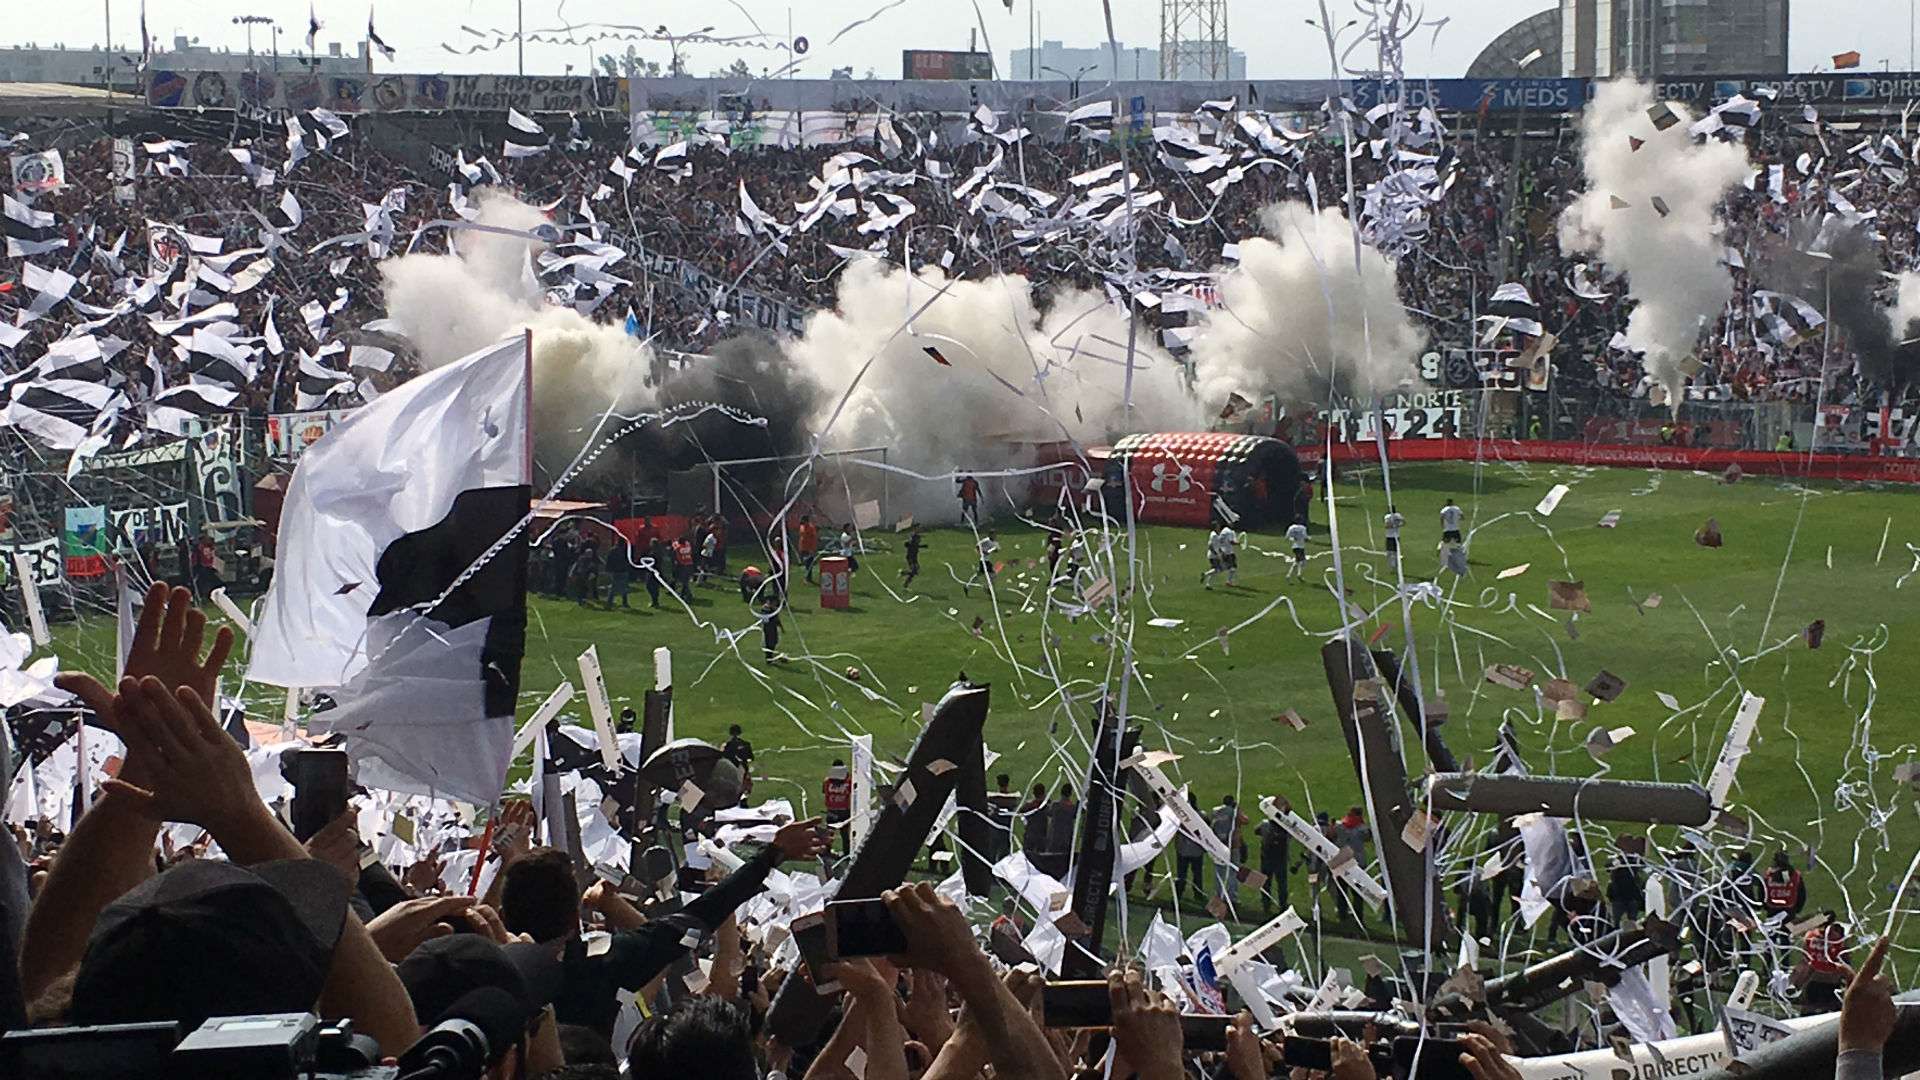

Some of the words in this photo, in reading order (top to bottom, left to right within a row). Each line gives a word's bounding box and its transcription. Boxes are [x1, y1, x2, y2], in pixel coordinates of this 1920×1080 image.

[1503, 88, 1569, 107] MEDS
[1397, 390, 1463, 408] NORTE
[1403, 408, 1459, 440] 24
[108, 511, 134, 553] K
[133, 511, 162, 528] DEL
[1643, 1051, 1723, 1080] DIRECTV
